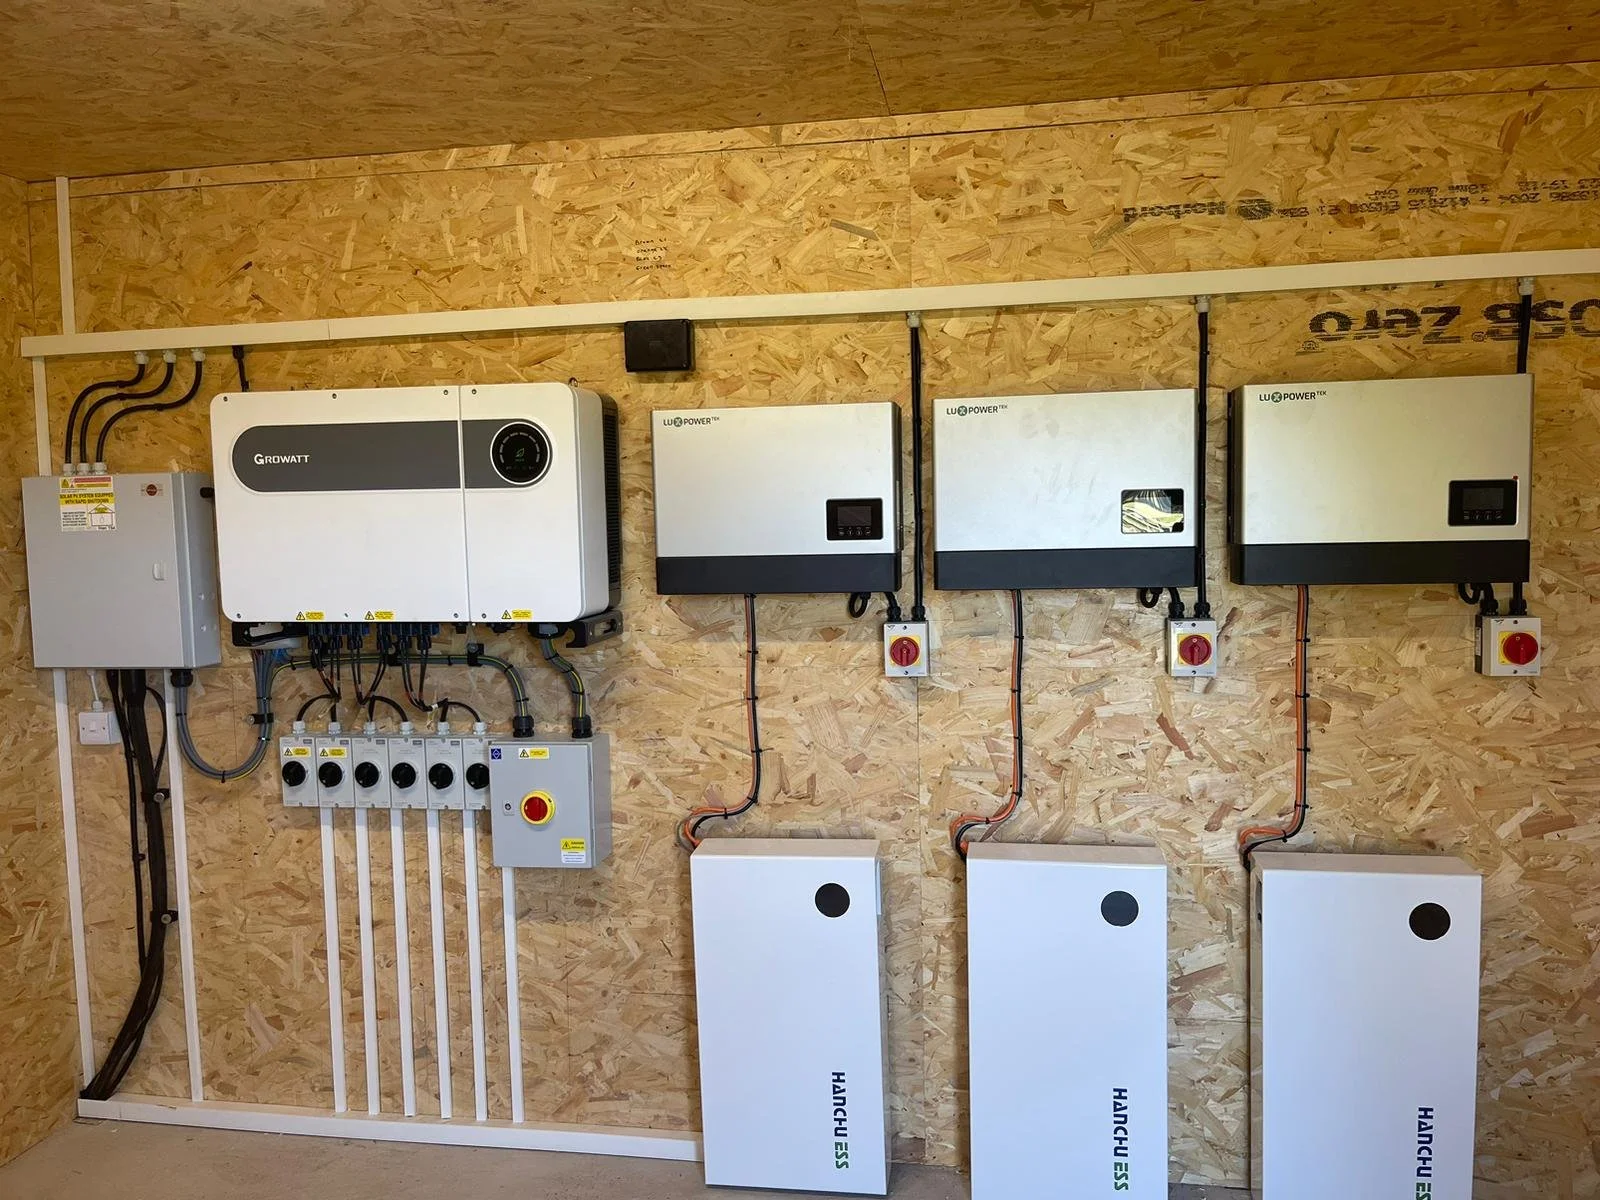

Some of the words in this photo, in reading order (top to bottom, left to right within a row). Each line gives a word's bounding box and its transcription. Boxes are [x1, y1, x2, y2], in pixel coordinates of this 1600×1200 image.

[1308, 305, 1462, 344] Zero
[834, 1141, 849, 1170] ESS
[1114, 1161, 1129, 1191] ESS
